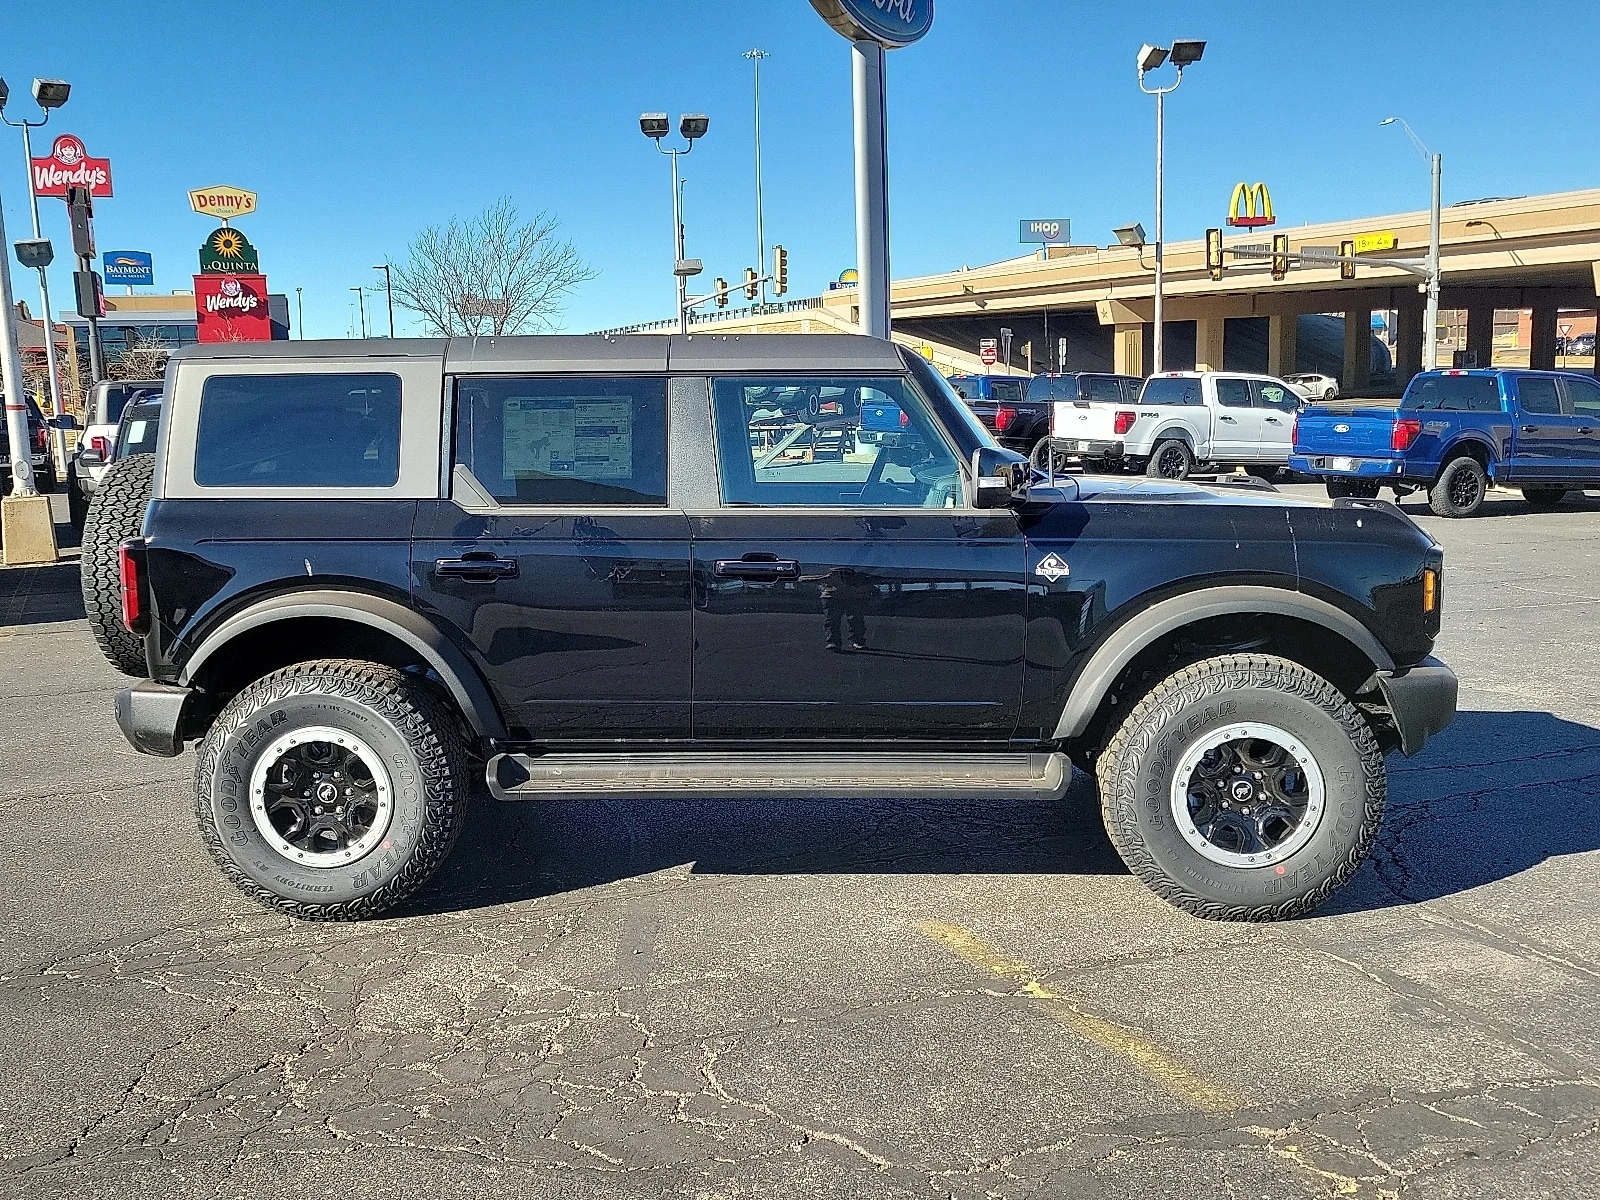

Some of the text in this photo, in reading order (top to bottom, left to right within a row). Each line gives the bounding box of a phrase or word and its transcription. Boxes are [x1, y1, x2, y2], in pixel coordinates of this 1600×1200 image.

[34, 162, 107, 190] Wendy's
[196, 194, 252, 209] Denny's
[105, 264, 151, 274] BAYMONT
[211, 260, 258, 272] QUINTA
[206, 291, 257, 312] Wendy's
